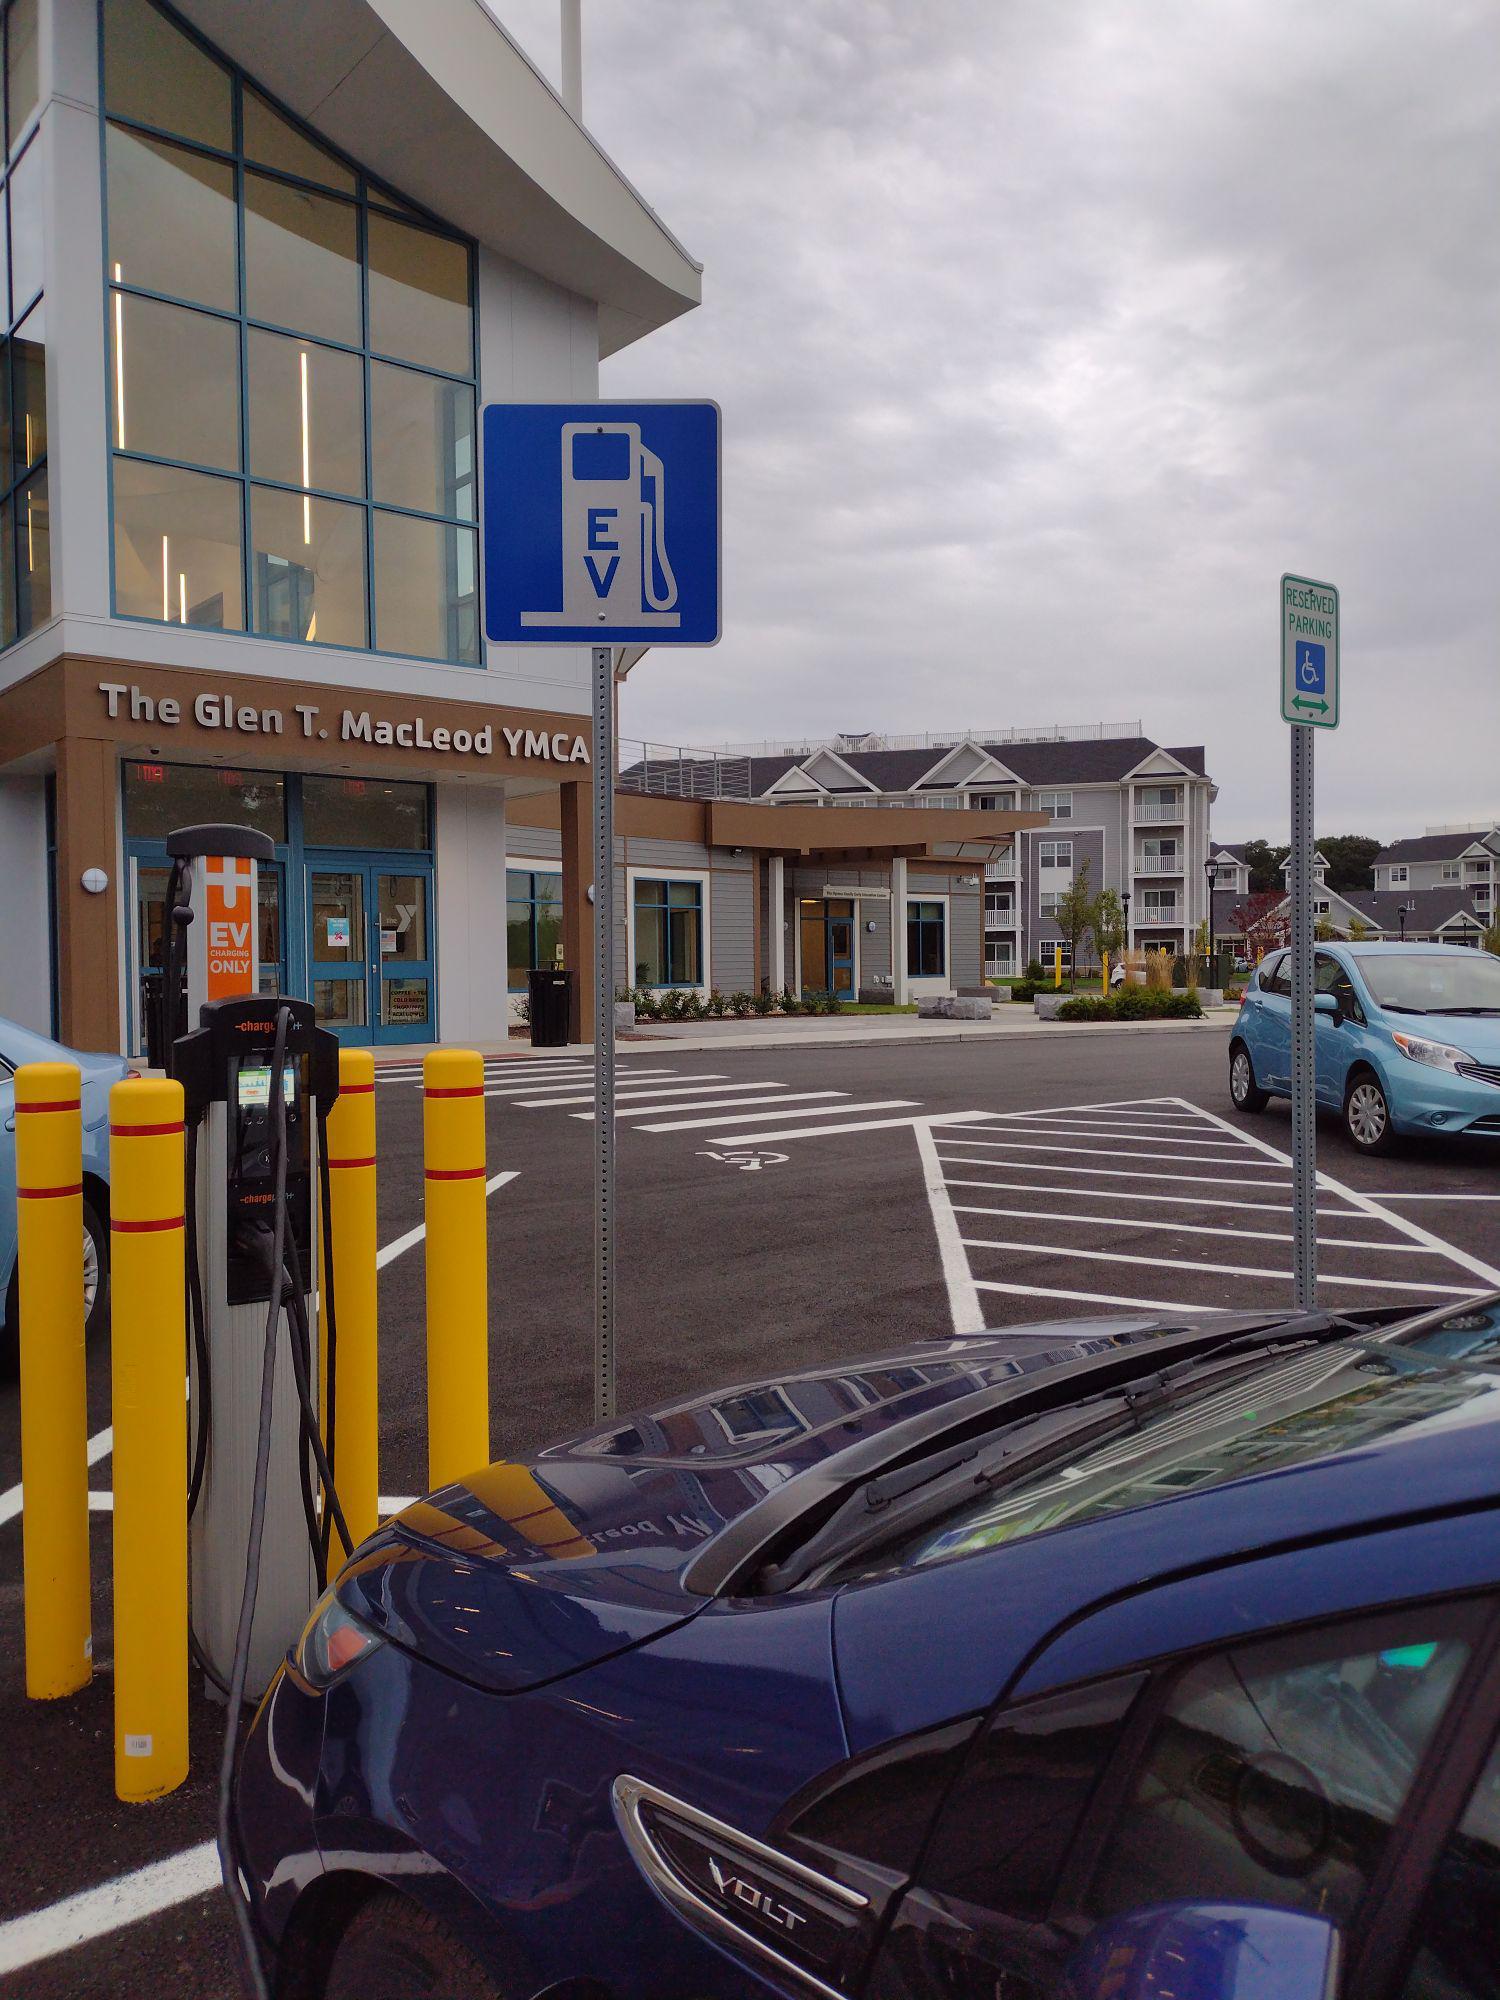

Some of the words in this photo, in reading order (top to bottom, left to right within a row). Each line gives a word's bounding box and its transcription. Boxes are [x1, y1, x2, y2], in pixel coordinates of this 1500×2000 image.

[583, 508, 621, 599] EV
[1286, 588, 1334, 614] RESERVED
[1289, 612, 1332, 639] PARKING
[98, 682, 181, 724] The
[194, 693, 283, 734] Glen
[295, 704, 329, 739] T.
[340, 709, 493, 755] MacLeod
[502, 727, 592, 764] YMCA
[210, 921, 250, 948] EV
[209, 959, 250, 975] ONLY
[210, 949, 250, 958] CHARGING
[708, 1856, 807, 1930] VOLT
